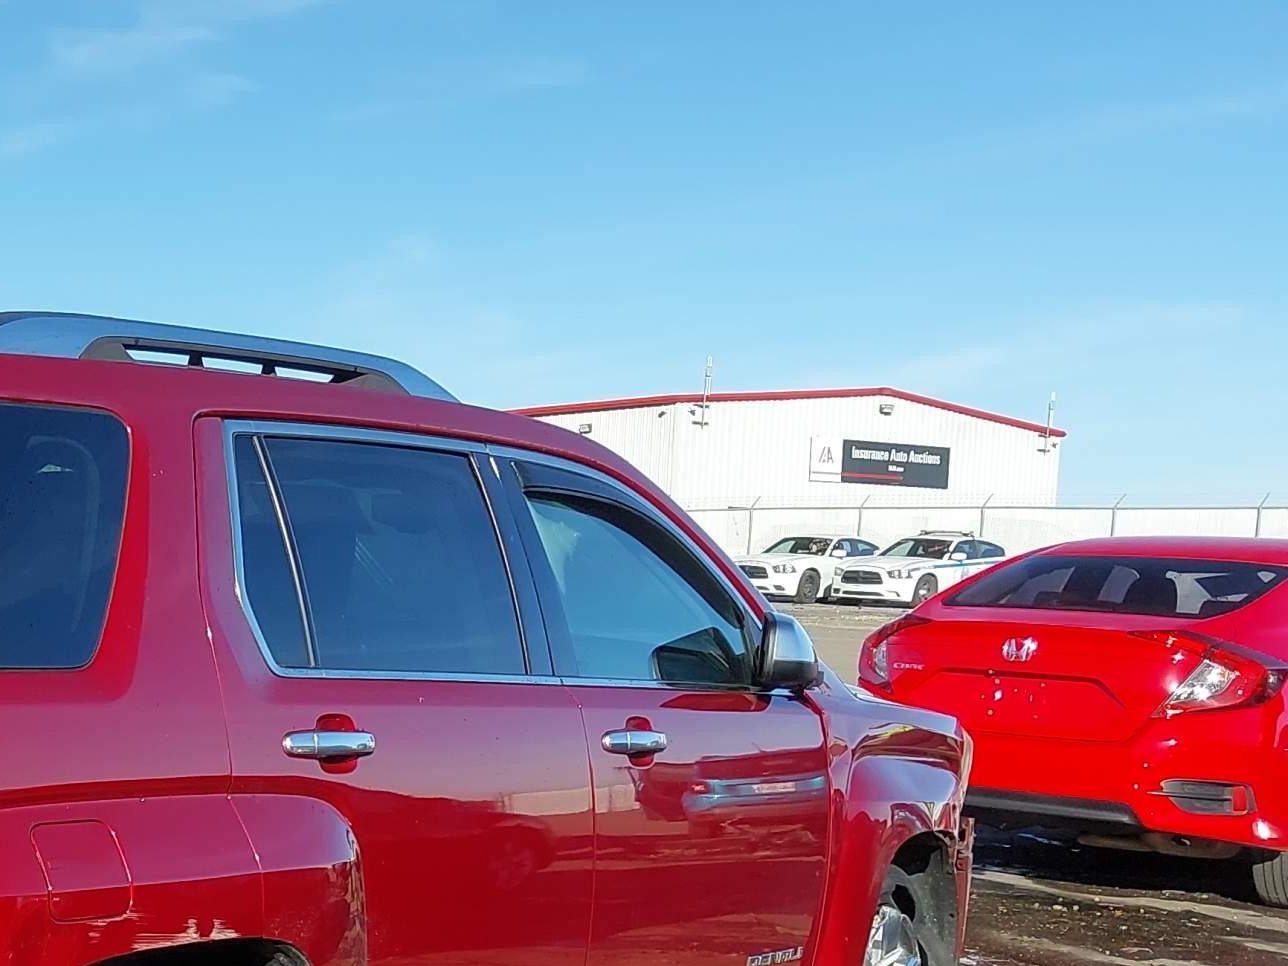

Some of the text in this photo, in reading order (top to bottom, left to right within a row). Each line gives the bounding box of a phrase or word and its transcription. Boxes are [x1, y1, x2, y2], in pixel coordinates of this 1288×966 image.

[851, 446, 941, 465] Insurance Auto Auctions
